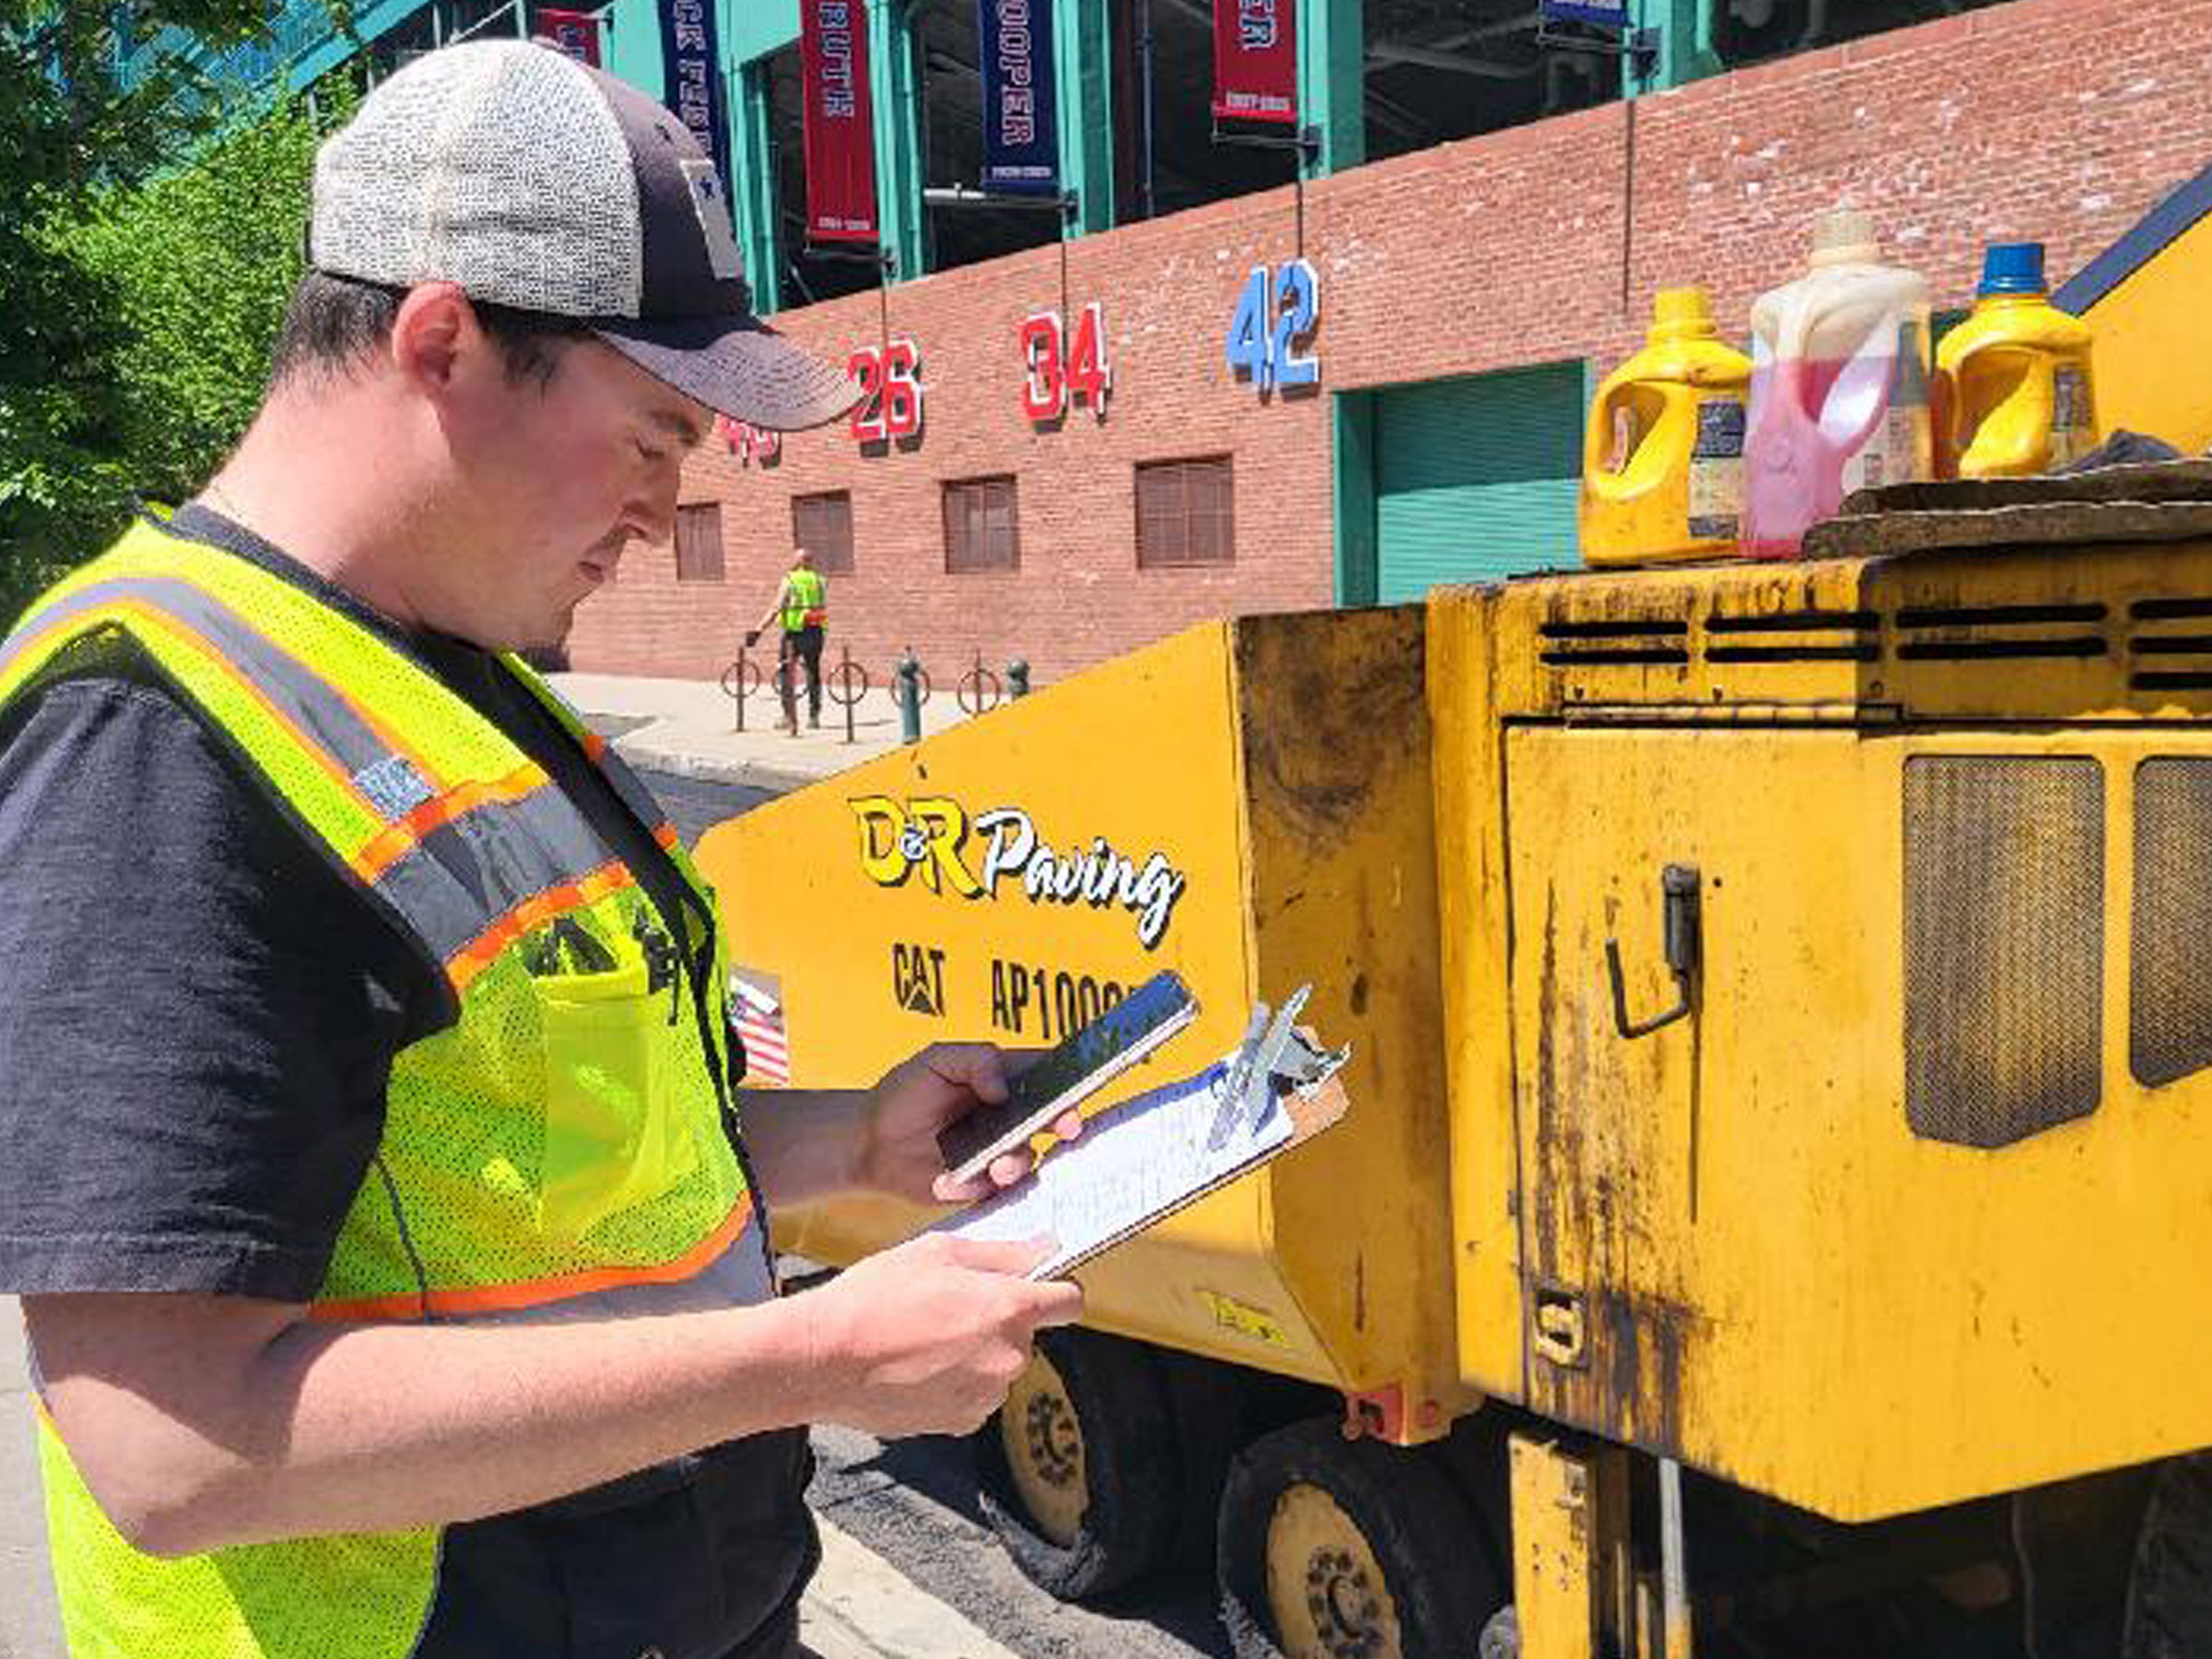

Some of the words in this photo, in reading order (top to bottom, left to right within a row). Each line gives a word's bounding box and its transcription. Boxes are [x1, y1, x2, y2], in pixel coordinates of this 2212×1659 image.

[674, 0, 707, 52] CK
[1019, 301, 1112, 423] 34
[1225, 257, 1319, 387] 42
[847, 339, 921, 440] 26
[847, 794, 984, 899] D&R
[975, 807, 1186, 950] Paving
[892, 942, 947, 1018] CAT
[992, 959, 1134, 1042] AP100
